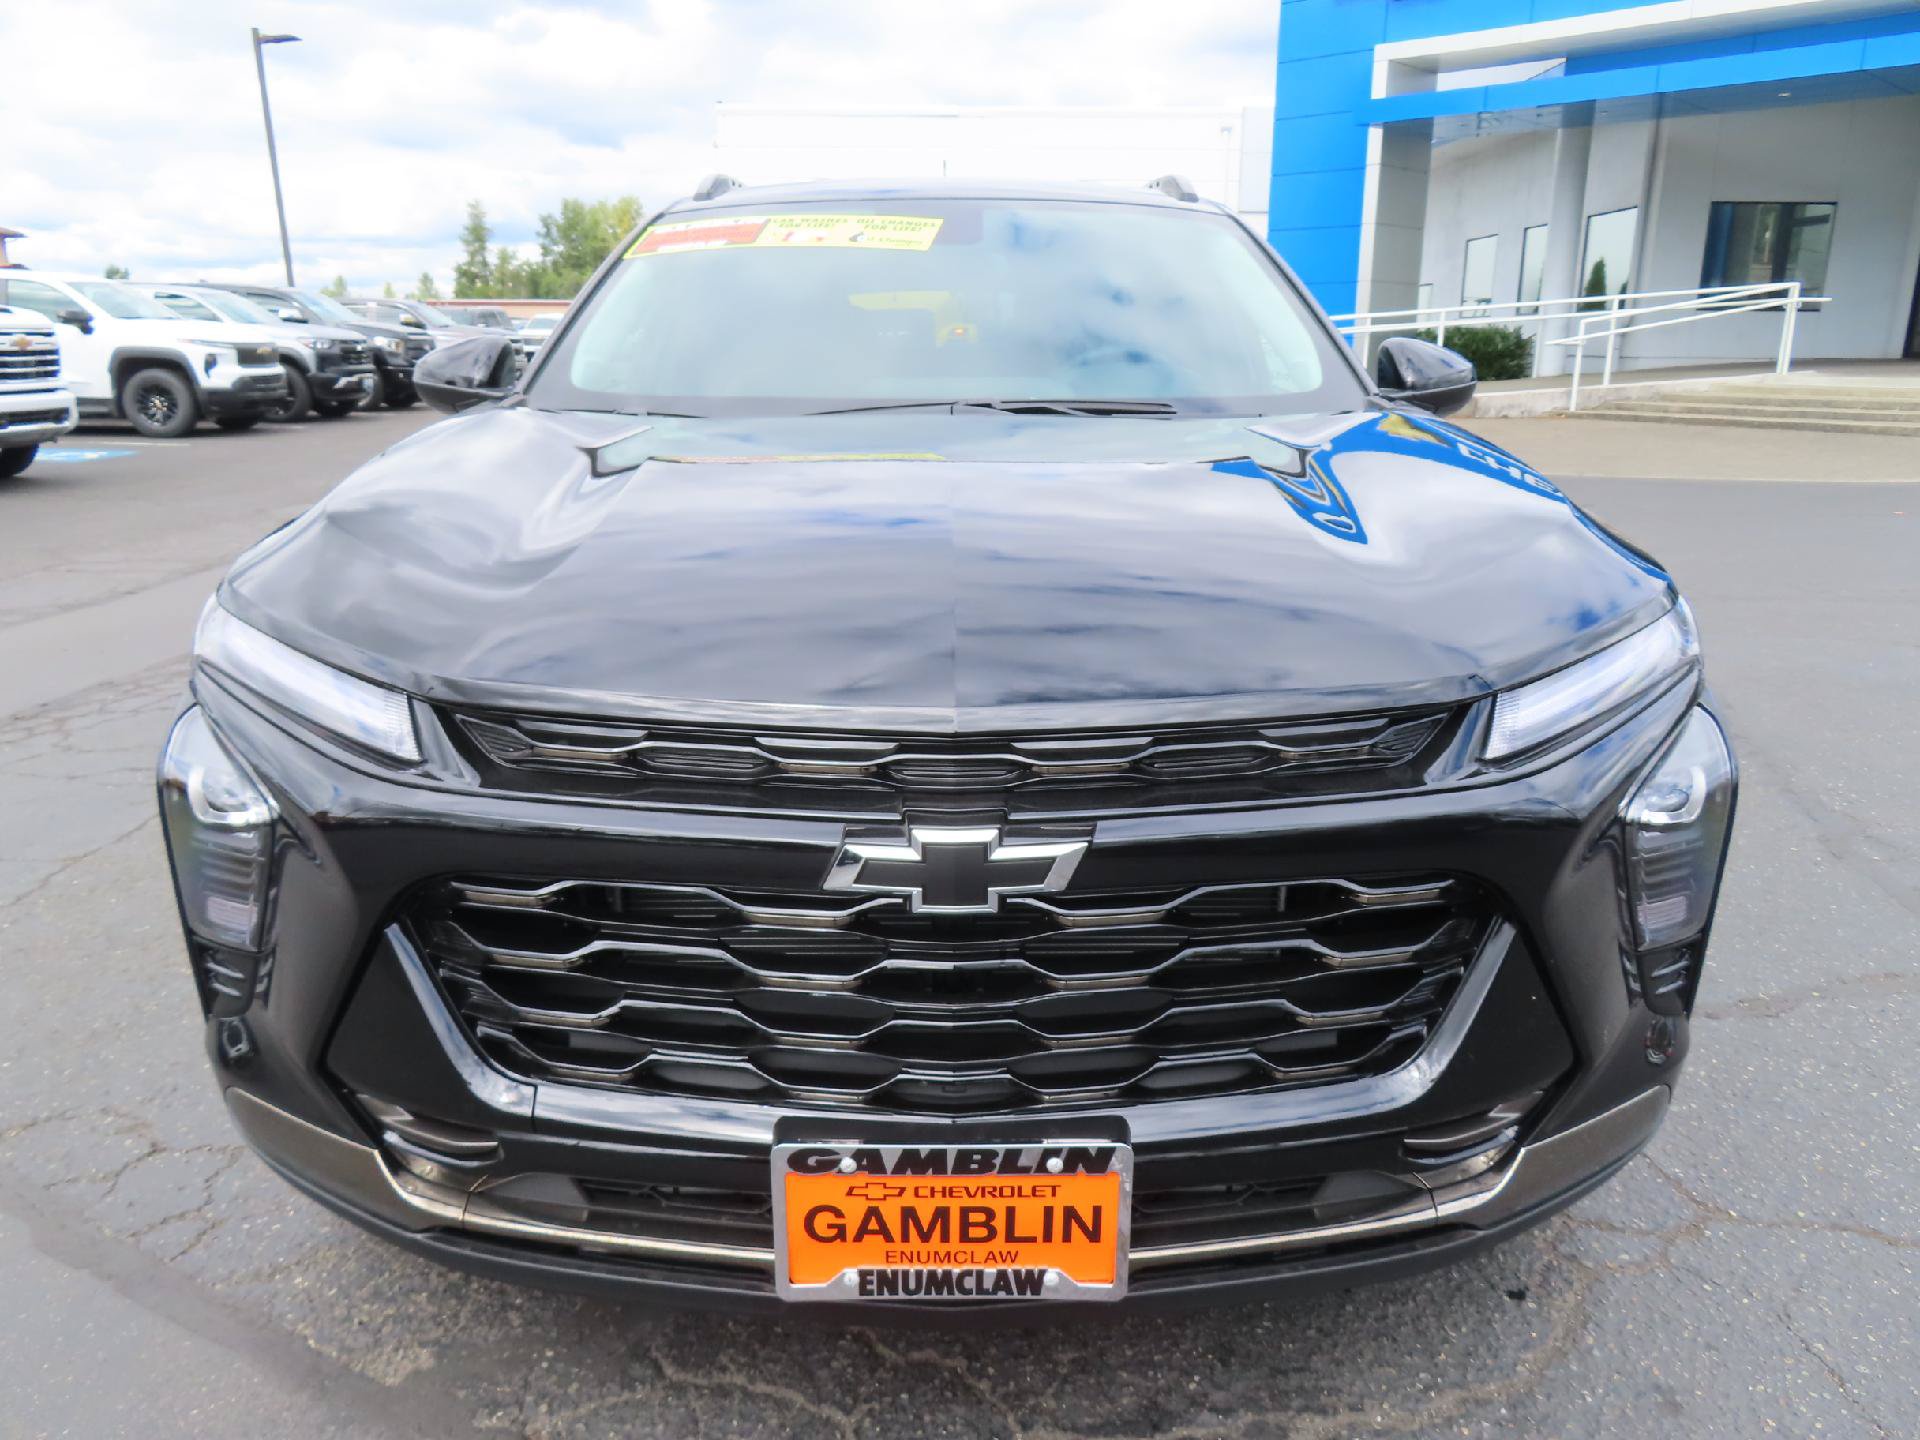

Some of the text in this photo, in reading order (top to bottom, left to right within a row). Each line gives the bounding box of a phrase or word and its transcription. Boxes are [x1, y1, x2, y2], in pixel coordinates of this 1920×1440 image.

[786, 1148, 1117, 1175] GAMBLIN
[913, 1184, 1061, 1199] CHEVROLET
[803, 1204, 1103, 1244] GAMBLIN
[885, 1250, 1019, 1265] ENUMCLAW
[858, 1269, 1047, 1297] ENUMCLAW
